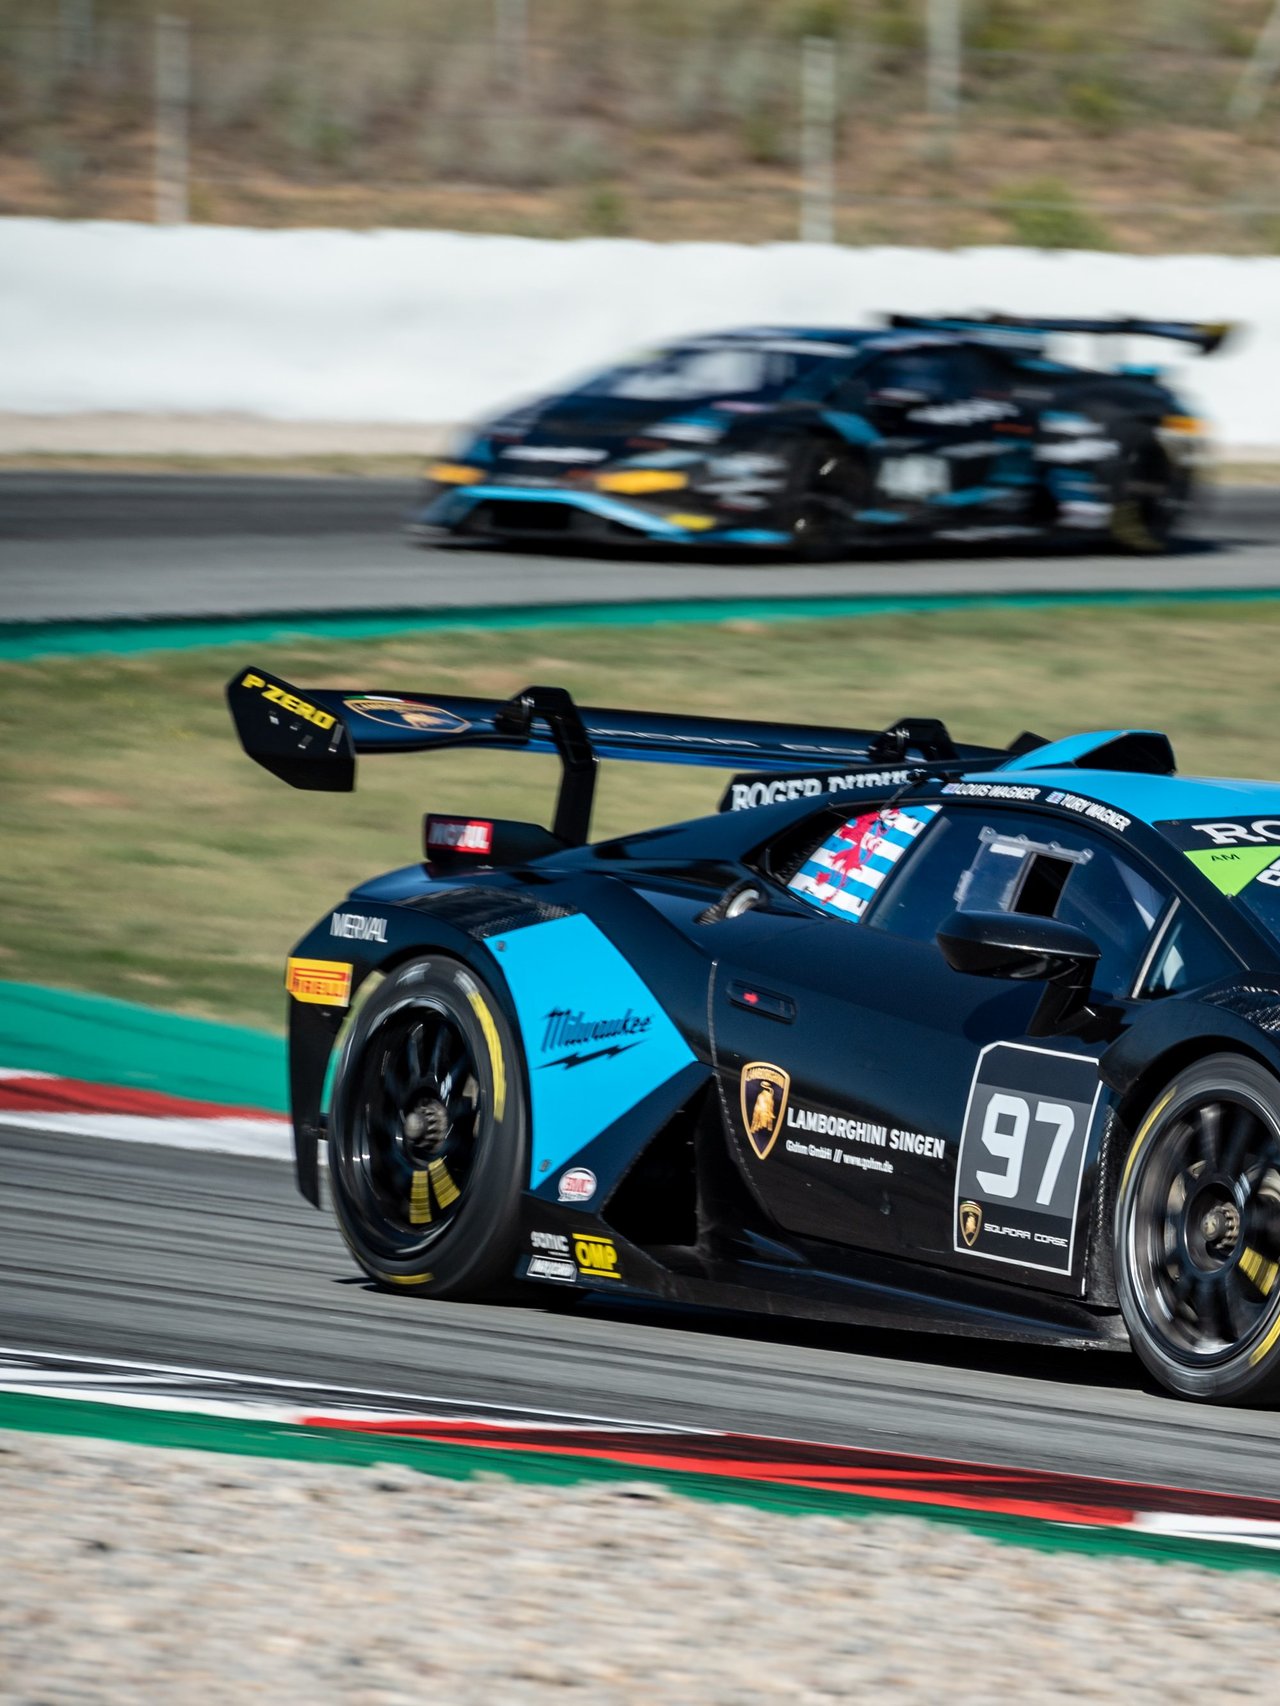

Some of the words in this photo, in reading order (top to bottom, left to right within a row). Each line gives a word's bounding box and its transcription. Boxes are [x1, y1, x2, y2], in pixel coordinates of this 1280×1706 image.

[241, 673, 267, 689] P
[261, 684, 337, 730] ZERO
[955, 783, 992, 797] LOUIS
[989, 785, 1041, 800] WAGNER
[1060, 793, 1089, 813] YURY
[1085, 802, 1131, 832] WAGNER
[428, 822, 490, 850] MOTUL
[1211, 853, 1240, 861] AM
[291, 967, 350, 998] PIRELLI
[541, 1008, 655, 1052] Milwaukee
[787, 1107, 887, 1147] LAMBORGHINI
[889, 1128, 945, 1159] SINGEN
[976, 1093, 1075, 1206] 97
[984, 1223, 1031, 1240] SQUADRA
[1034, 1233, 1069, 1247] CORSE
[575, 1241, 618, 1270] OMP
